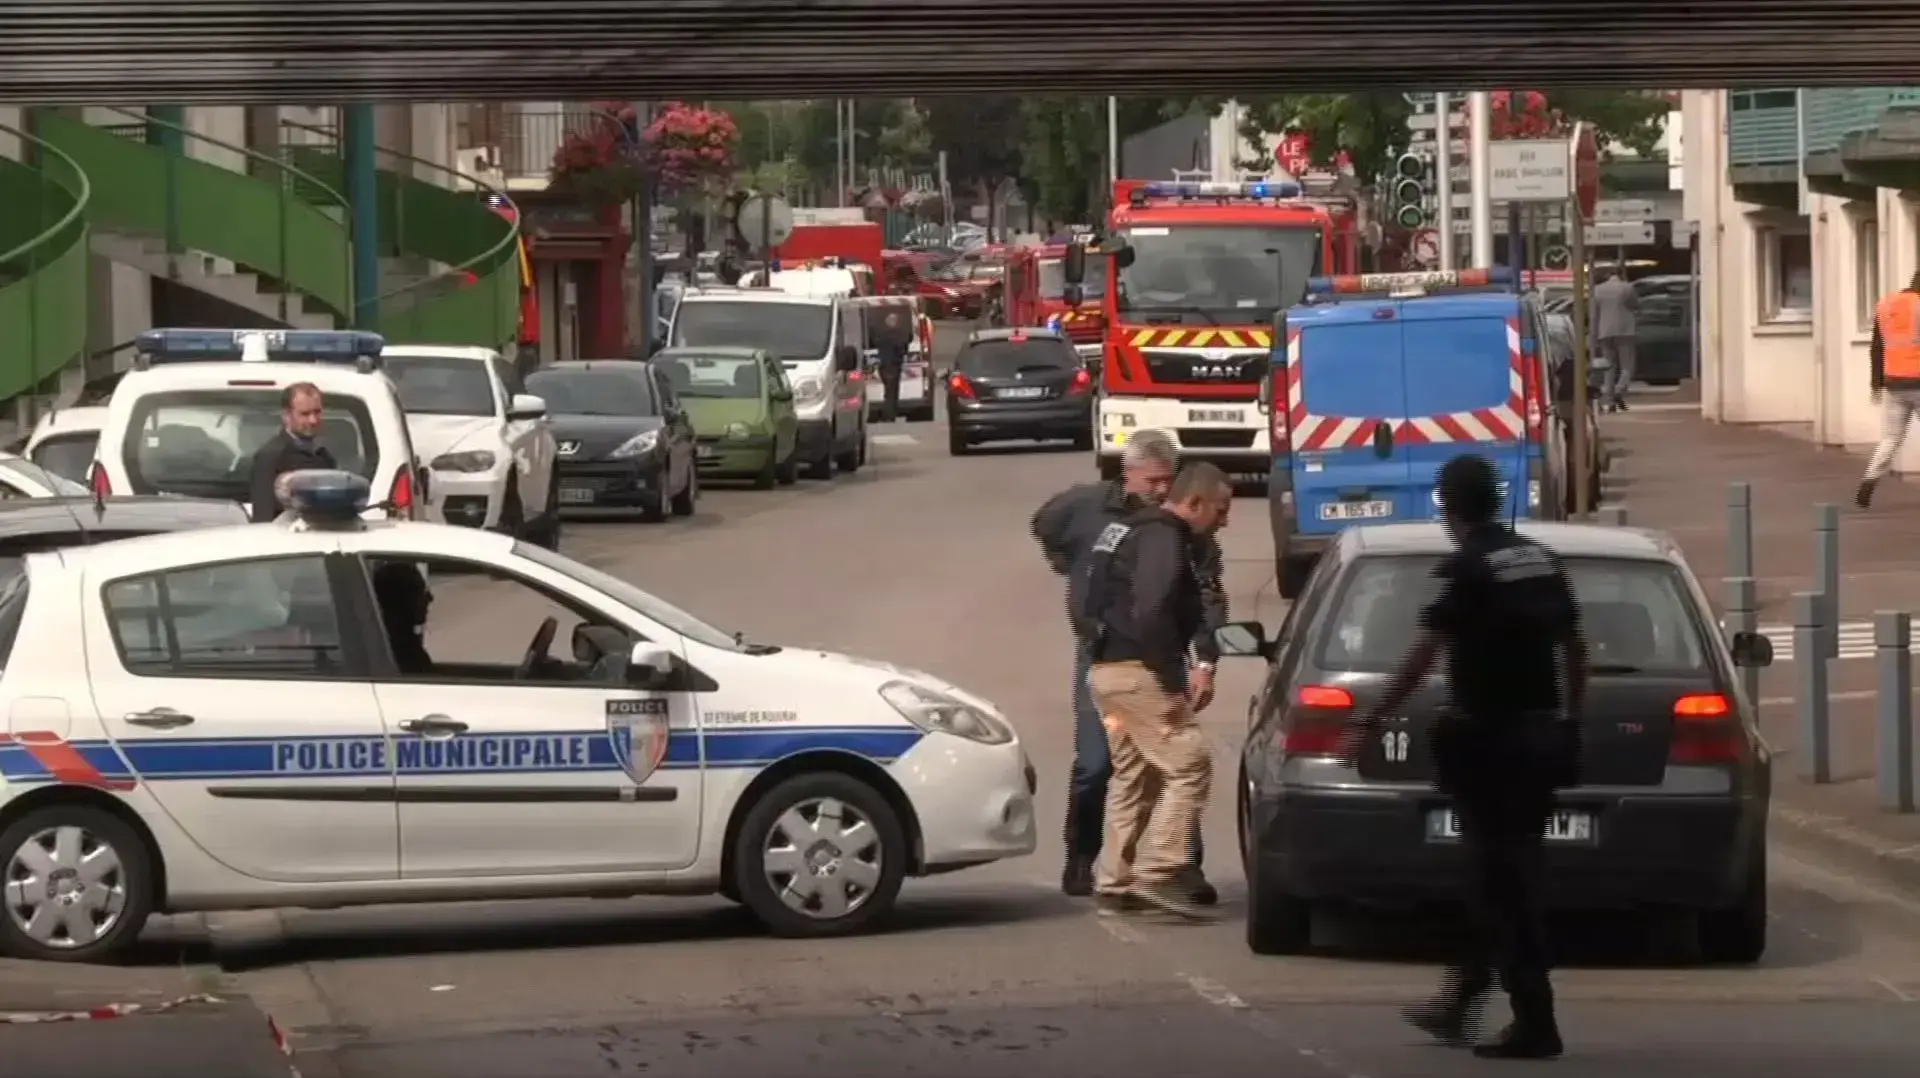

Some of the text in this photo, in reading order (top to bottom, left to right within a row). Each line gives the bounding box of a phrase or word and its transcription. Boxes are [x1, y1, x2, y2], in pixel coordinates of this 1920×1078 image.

[1283, 142, 1300, 156] LE
[1191, 366, 1242, 377] MAN
[609, 702, 664, 713] POLICE
[749, 711, 761, 723] DE
[277, 737, 584, 770] POLICE MUNICIPALE
